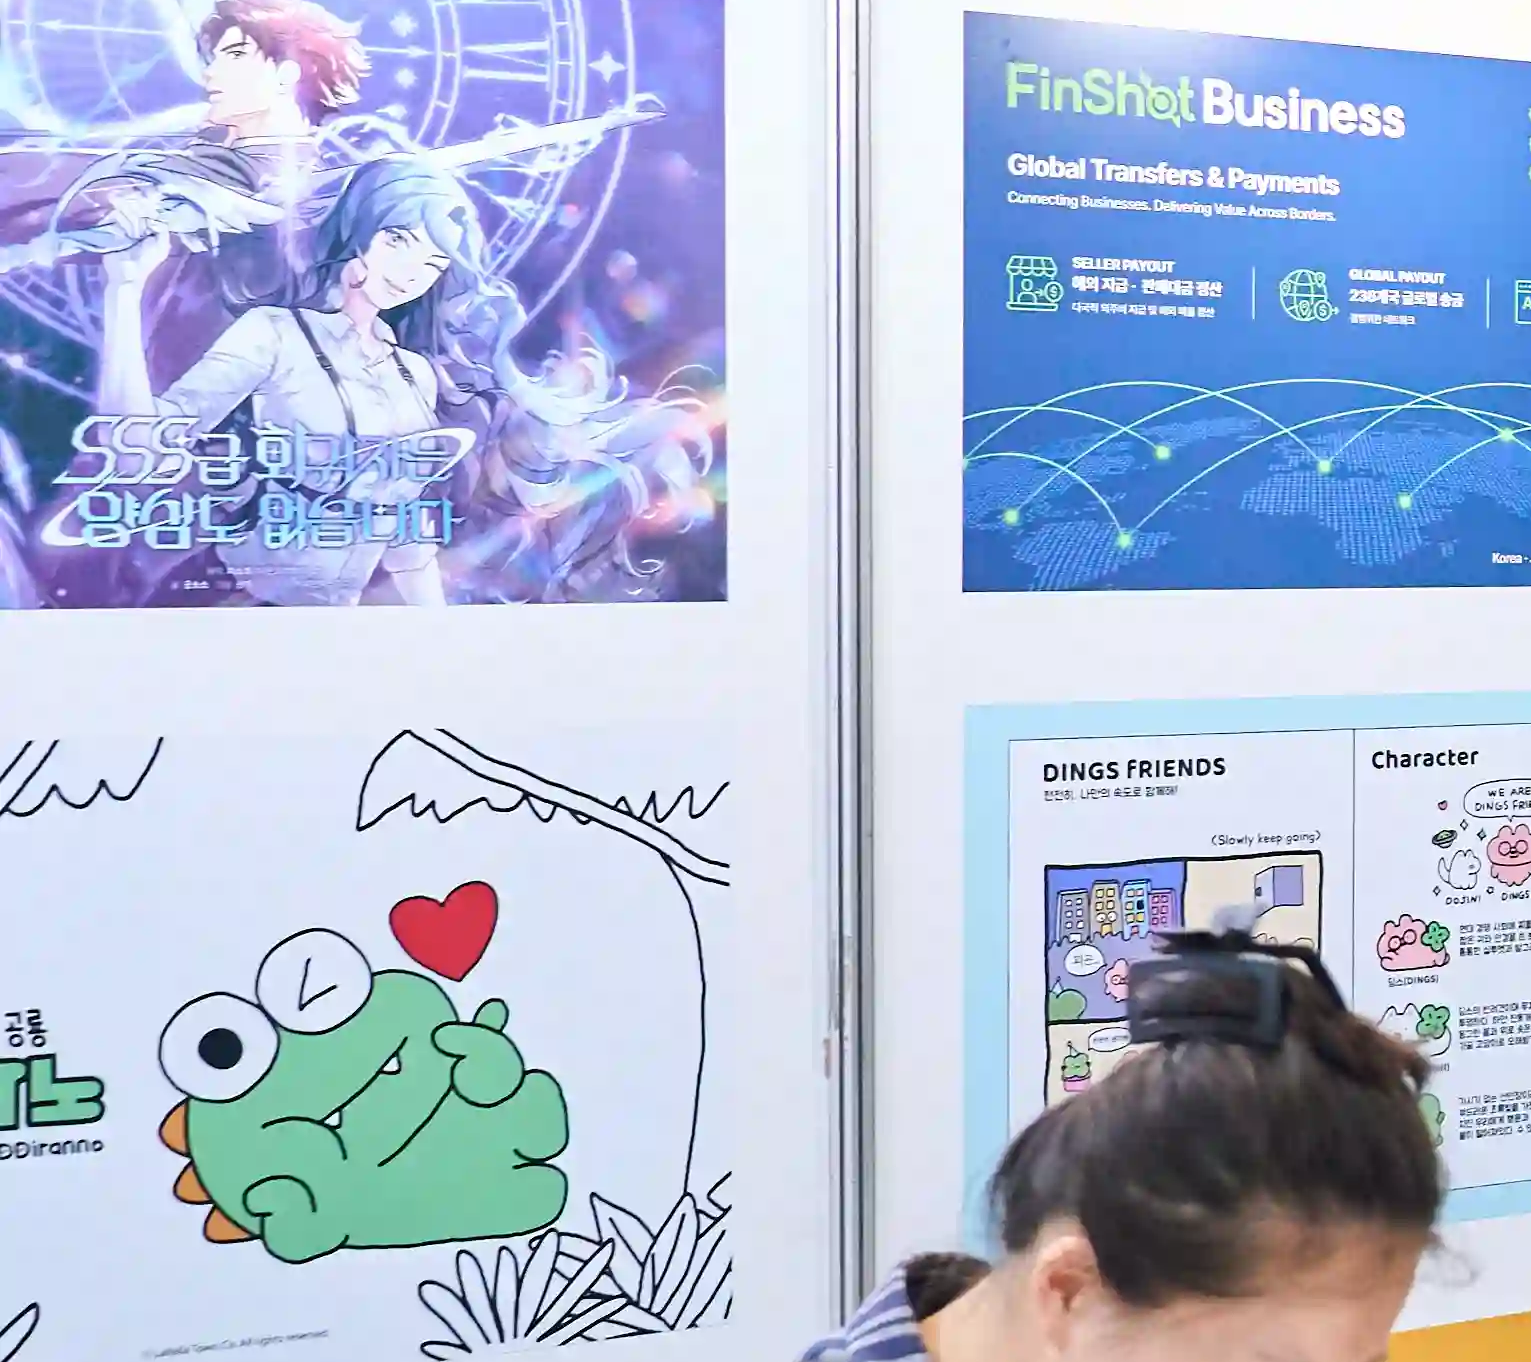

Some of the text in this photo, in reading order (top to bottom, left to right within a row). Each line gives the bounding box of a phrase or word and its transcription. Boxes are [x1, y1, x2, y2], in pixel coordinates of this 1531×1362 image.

[1005, 61, 1406, 138] FinShot Business
[1007, 153, 1340, 196] Global Transfers & Payments
[1007, 190, 1336, 221] Connecting Businesses. Delivering Value Across Borders.
[1071, 256, 1121, 271] SELLER
[1348, 268, 1397, 283] GLOBAL
[257, 489, 466, 551] 없습니다
[1491, 552, 1523, 564] Korea
[1371, 750, 1479, 769] Character
[1043, 757, 1227, 782] DINGS FRIENDS
[1487, 786, 1531, 797] WE ARE
[1474, 801, 1509, 811] DINGS
[1257, 833, 1282, 846] keep
[1501, 890, 1531, 901] DINGS
[4, 1008, 49, 1048] 공룡
